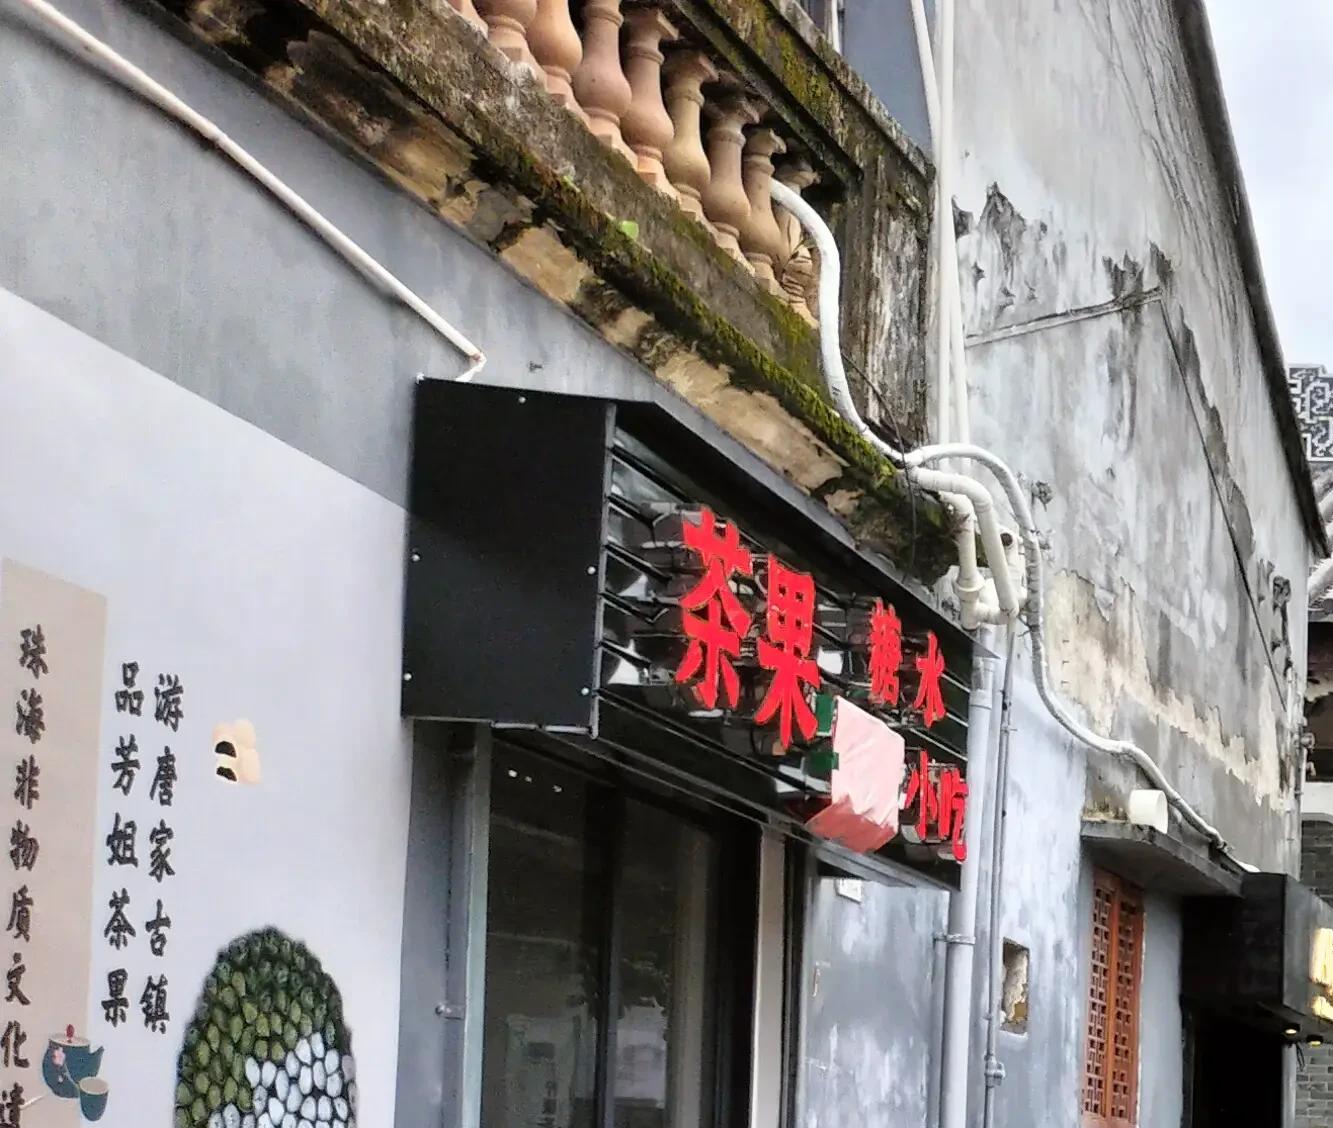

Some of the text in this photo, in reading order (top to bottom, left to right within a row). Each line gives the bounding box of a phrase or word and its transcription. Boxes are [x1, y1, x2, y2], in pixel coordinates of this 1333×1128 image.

[676, 504, 819, 751] 茶果
[867, 598, 946, 728] 糖水
[101, 660, 145, 1028] 品芳姐茶果
[904, 749, 969, 863] 小吃
